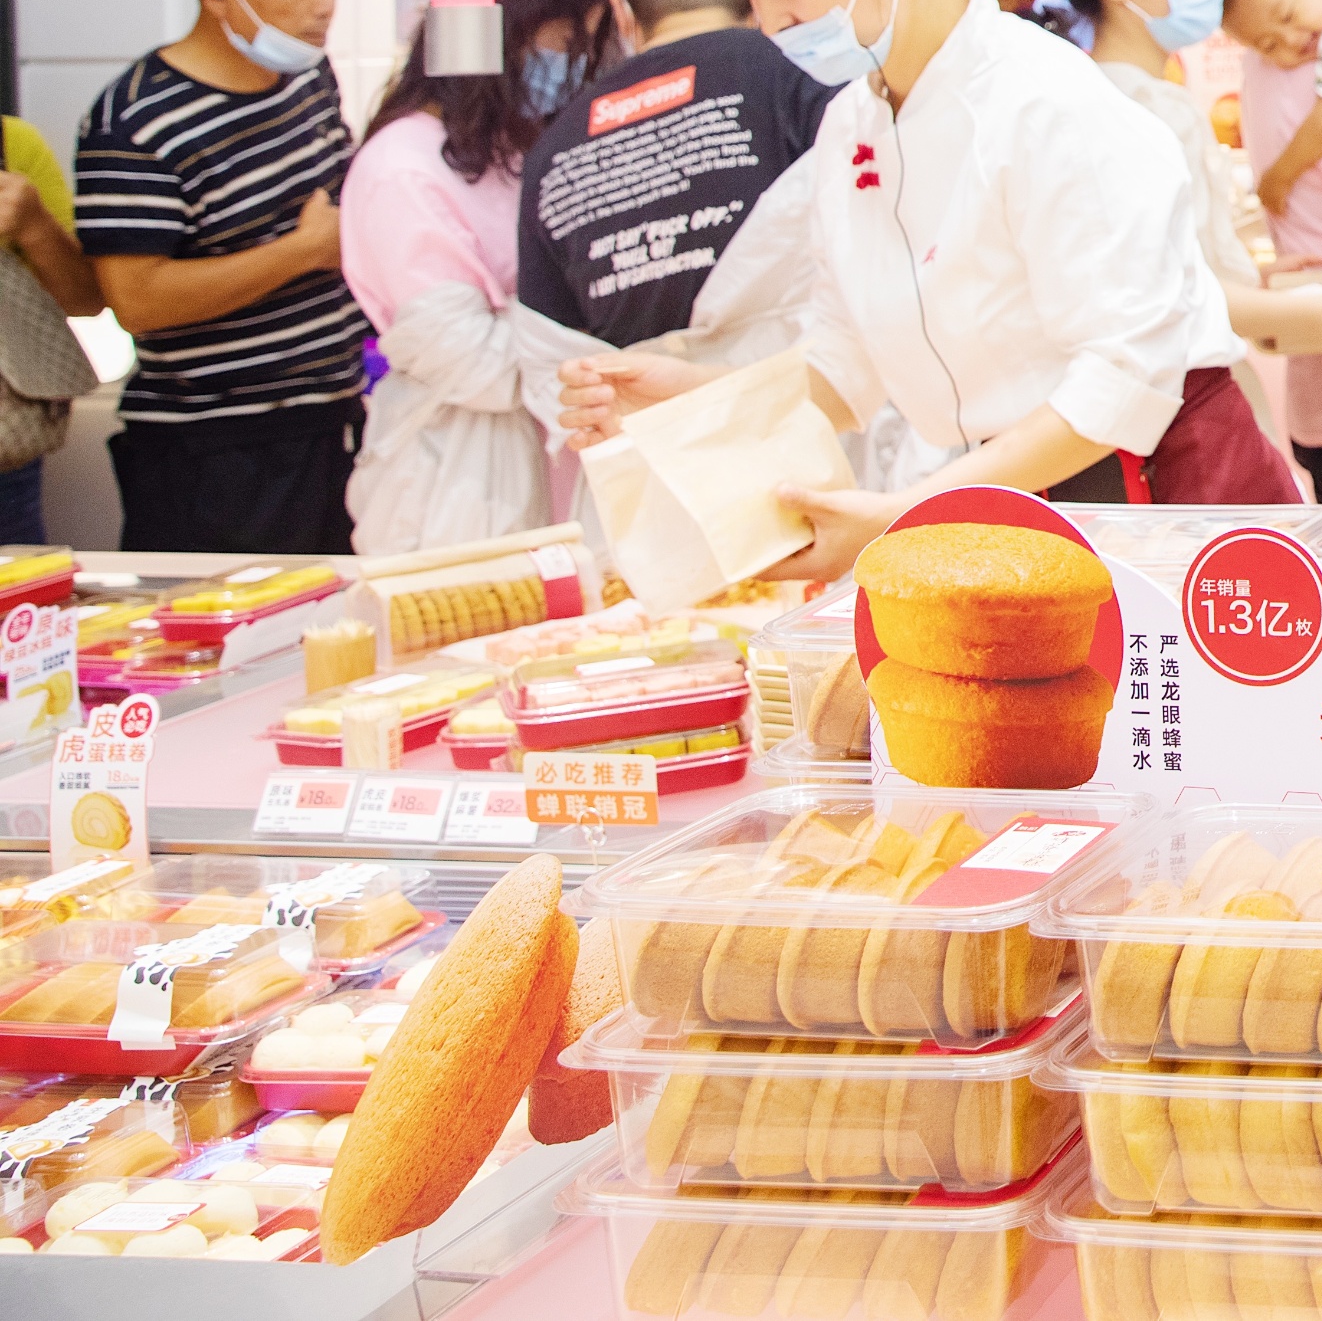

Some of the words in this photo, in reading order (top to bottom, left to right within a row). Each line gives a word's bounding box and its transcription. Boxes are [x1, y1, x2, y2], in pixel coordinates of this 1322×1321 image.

[593, 77, 692, 125] Supreme
[1199, 577, 1252, 597] 年销量
[1129, 634, 1152, 771] 不添加一滴水
[1159, 634, 1182, 772] 严选龙眼蜂蜜
[87, 742, 146, 763] 蛋糕卷
[535, 759, 646, 787] 必吃推荐
[536, 792, 649, 821] 蝉联销冠
